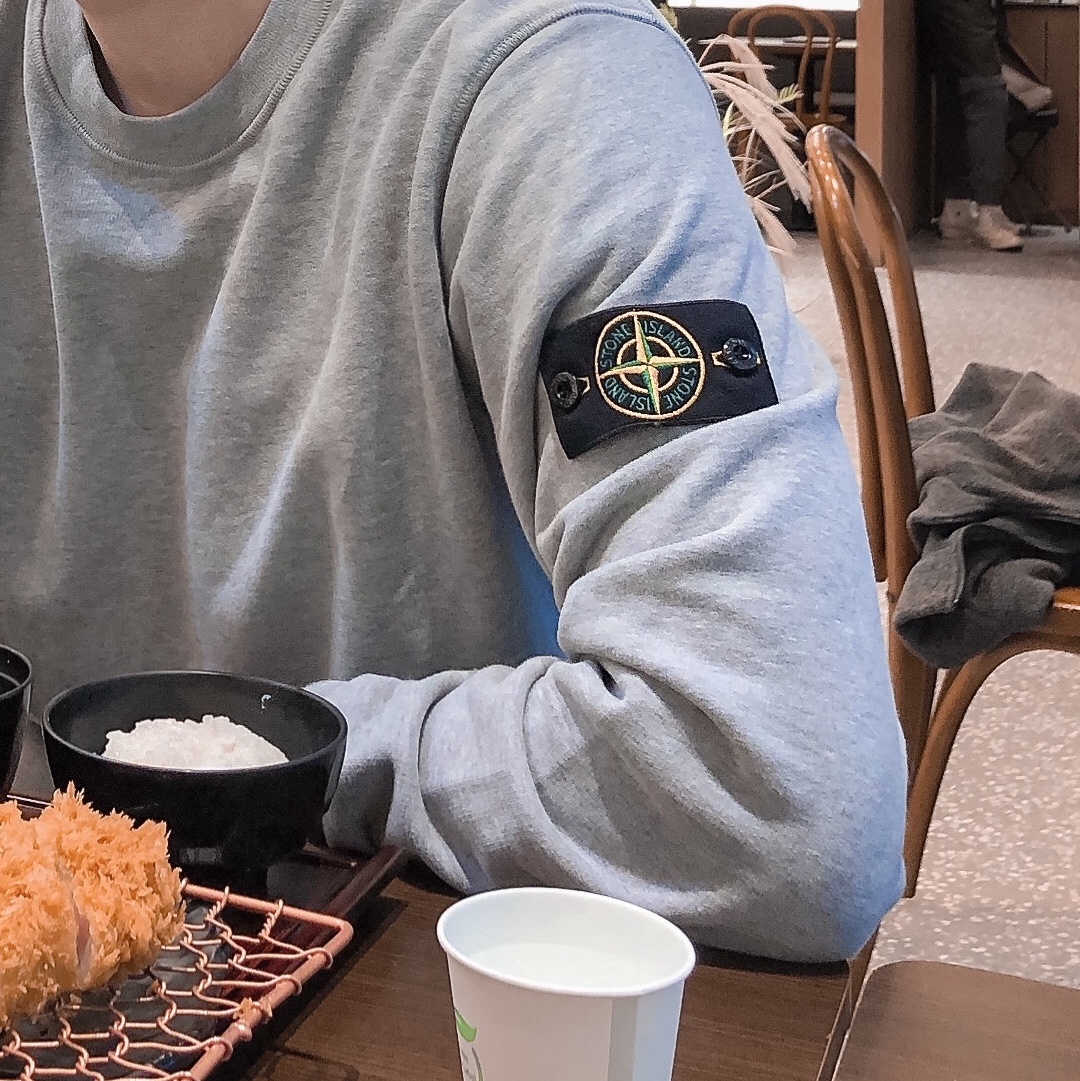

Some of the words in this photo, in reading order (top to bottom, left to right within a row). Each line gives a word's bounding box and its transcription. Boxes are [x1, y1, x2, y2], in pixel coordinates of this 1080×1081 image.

[600, 323, 632, 368] STONE
[643, 320, 691, 357] ISLAND
[604, 377, 651, 411] ISLAND
[664, 367, 697, 410] STONE
